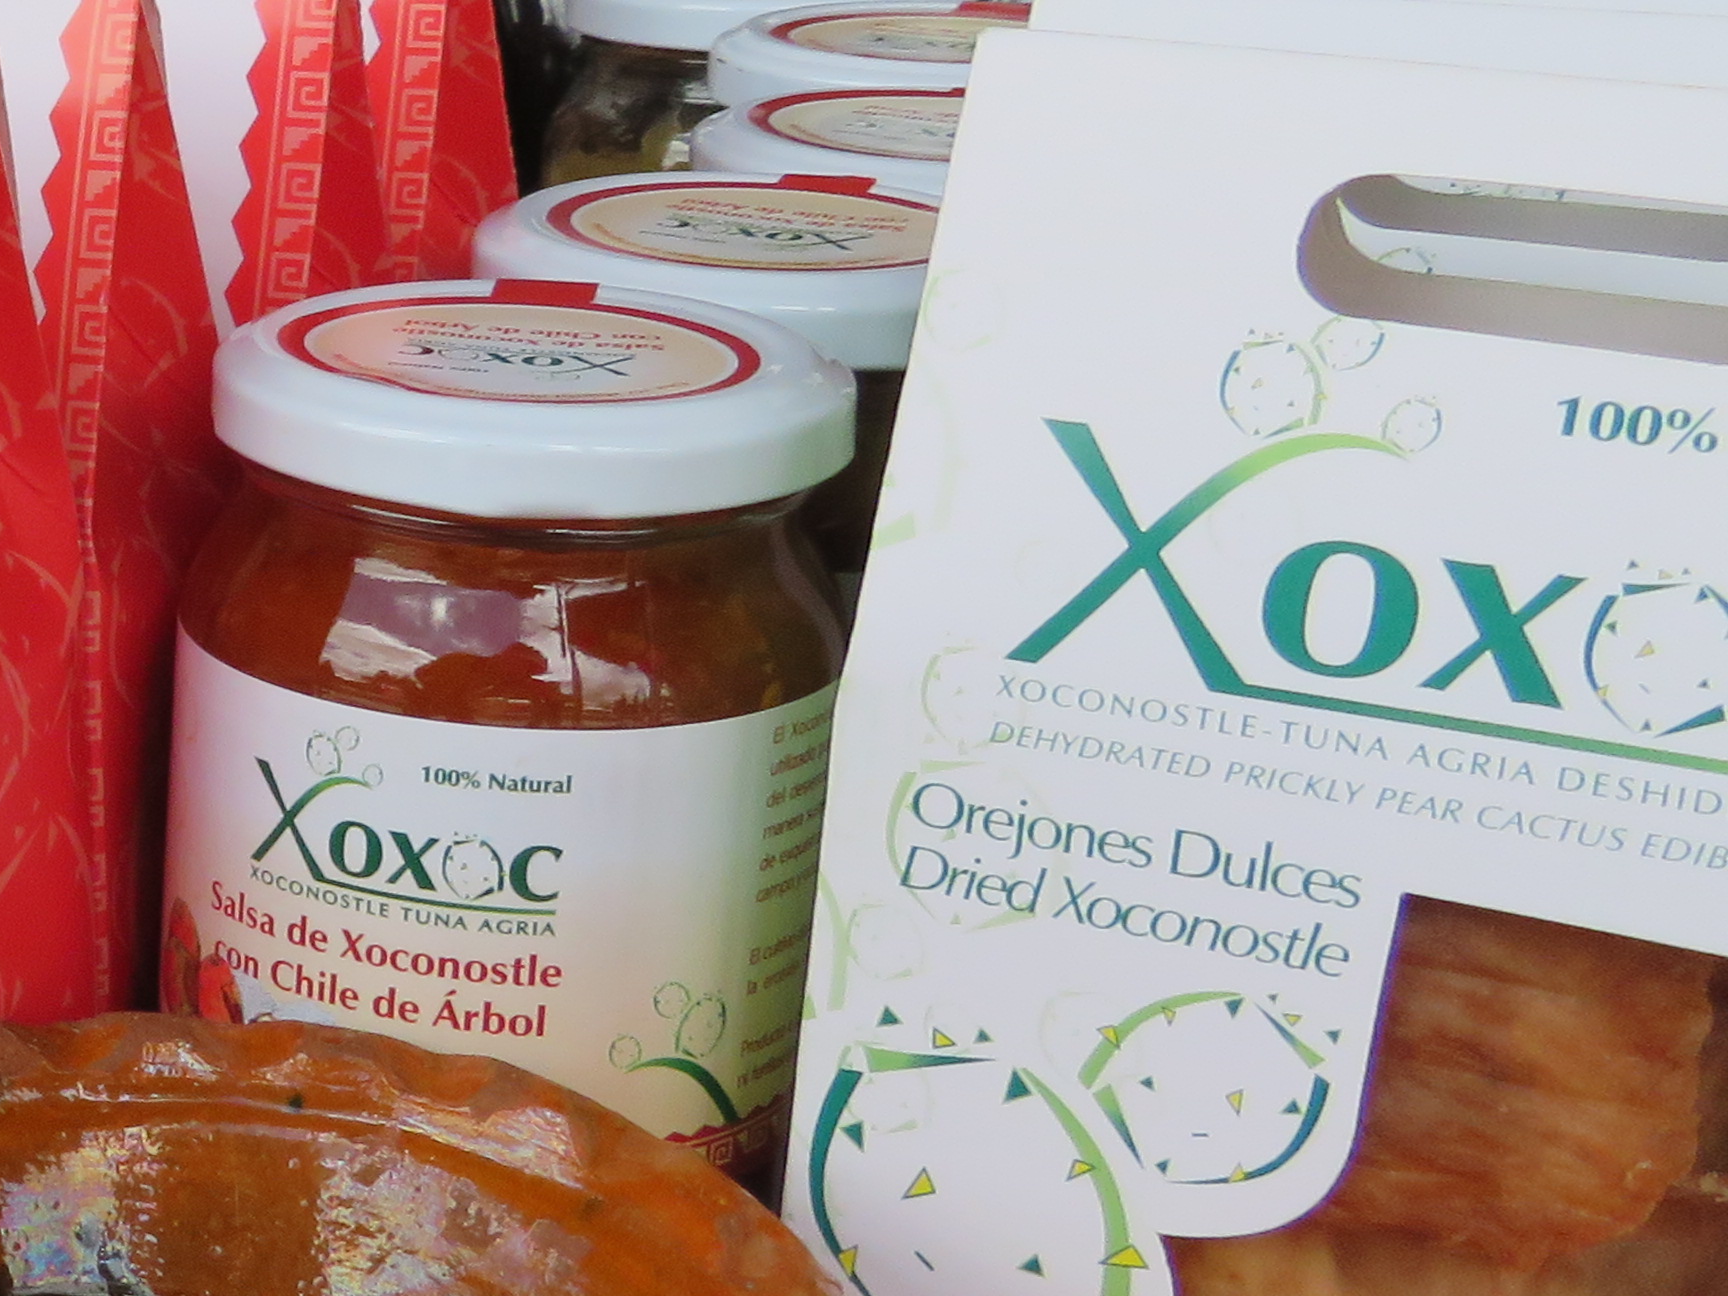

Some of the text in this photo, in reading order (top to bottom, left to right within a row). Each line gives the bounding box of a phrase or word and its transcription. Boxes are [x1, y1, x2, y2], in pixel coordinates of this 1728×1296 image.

[1555, 394, 1721, 456] 100%
[1004, 416, 1728, 759] Xoxo
[420, 764, 573, 794] 100% Natural
[989, 719, 1213, 782] DEHYDRATED
[1223, 760, 1368, 806] PRICKLY
[1374, 786, 1464, 823] PEAR
[1476, 805, 1629, 853] CACTUS
[994, 673, 1728, 816] XOCONOSTLE-TUNA AGRIA DESHID
[249, 755, 564, 916] Xoxoc
[249, 863, 557, 937] XOCONOSTLE TUNA AGRIA
[910, 780, 1365, 910] Orejones Dulces
[210, 879, 564, 988] Salsa de Xoconostle
[899, 844, 1353, 978] Dried Xoconostle
[214, 939, 548, 1039] con Chile de Árbol
